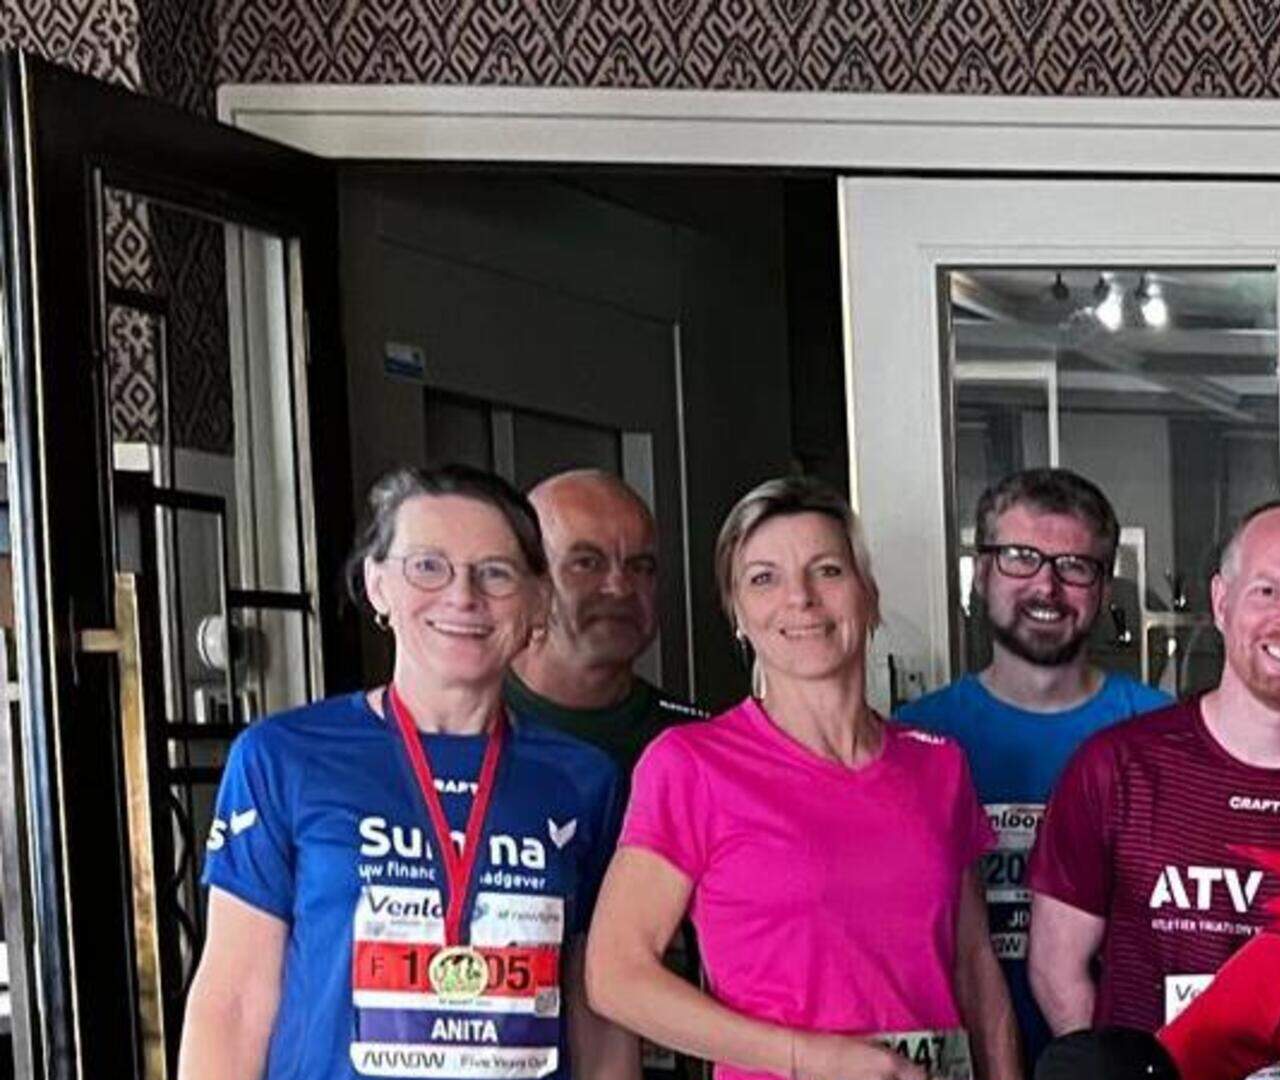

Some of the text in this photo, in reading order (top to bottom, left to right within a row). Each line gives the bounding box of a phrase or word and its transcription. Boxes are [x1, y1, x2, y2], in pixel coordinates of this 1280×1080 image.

[480, 871, 546, 889] adgever
[1150, 865, 1264, 913] ATV
[371, 951, 531, 990] F 105
[431, 1018, 498, 1042] ANITA
